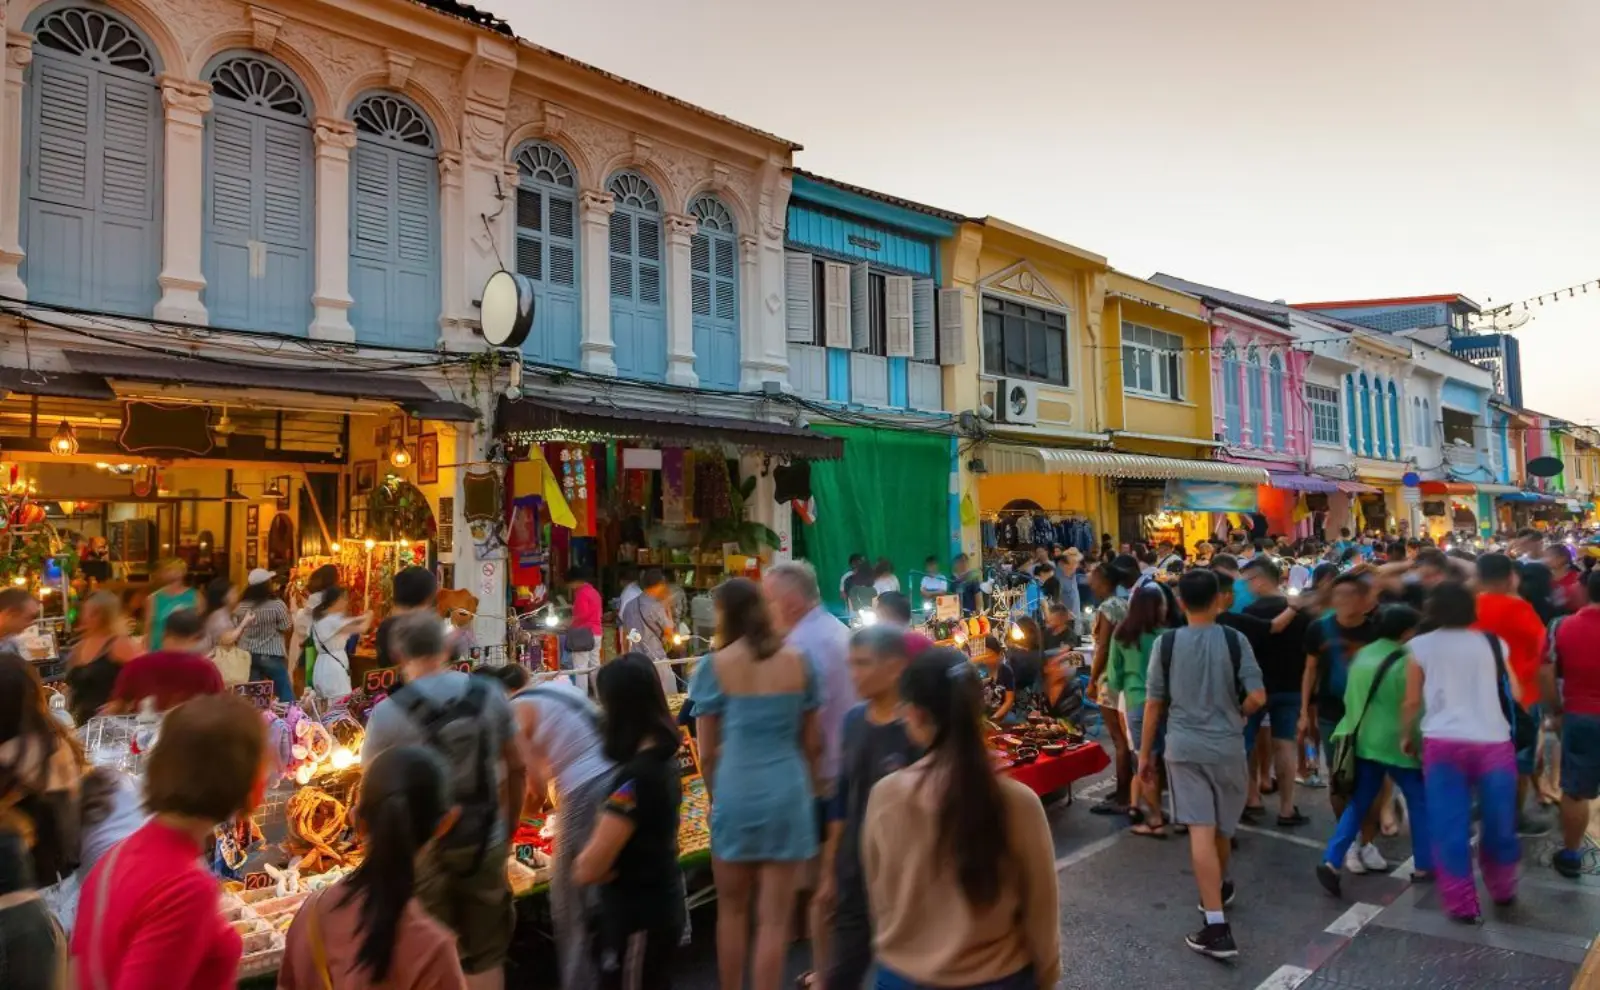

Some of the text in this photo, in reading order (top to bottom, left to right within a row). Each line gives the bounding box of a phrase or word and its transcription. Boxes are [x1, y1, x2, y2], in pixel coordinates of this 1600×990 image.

[367, 669, 394, 690] 50
[518, 845, 532, 859] 10
[248, 874, 267, 889] 20
